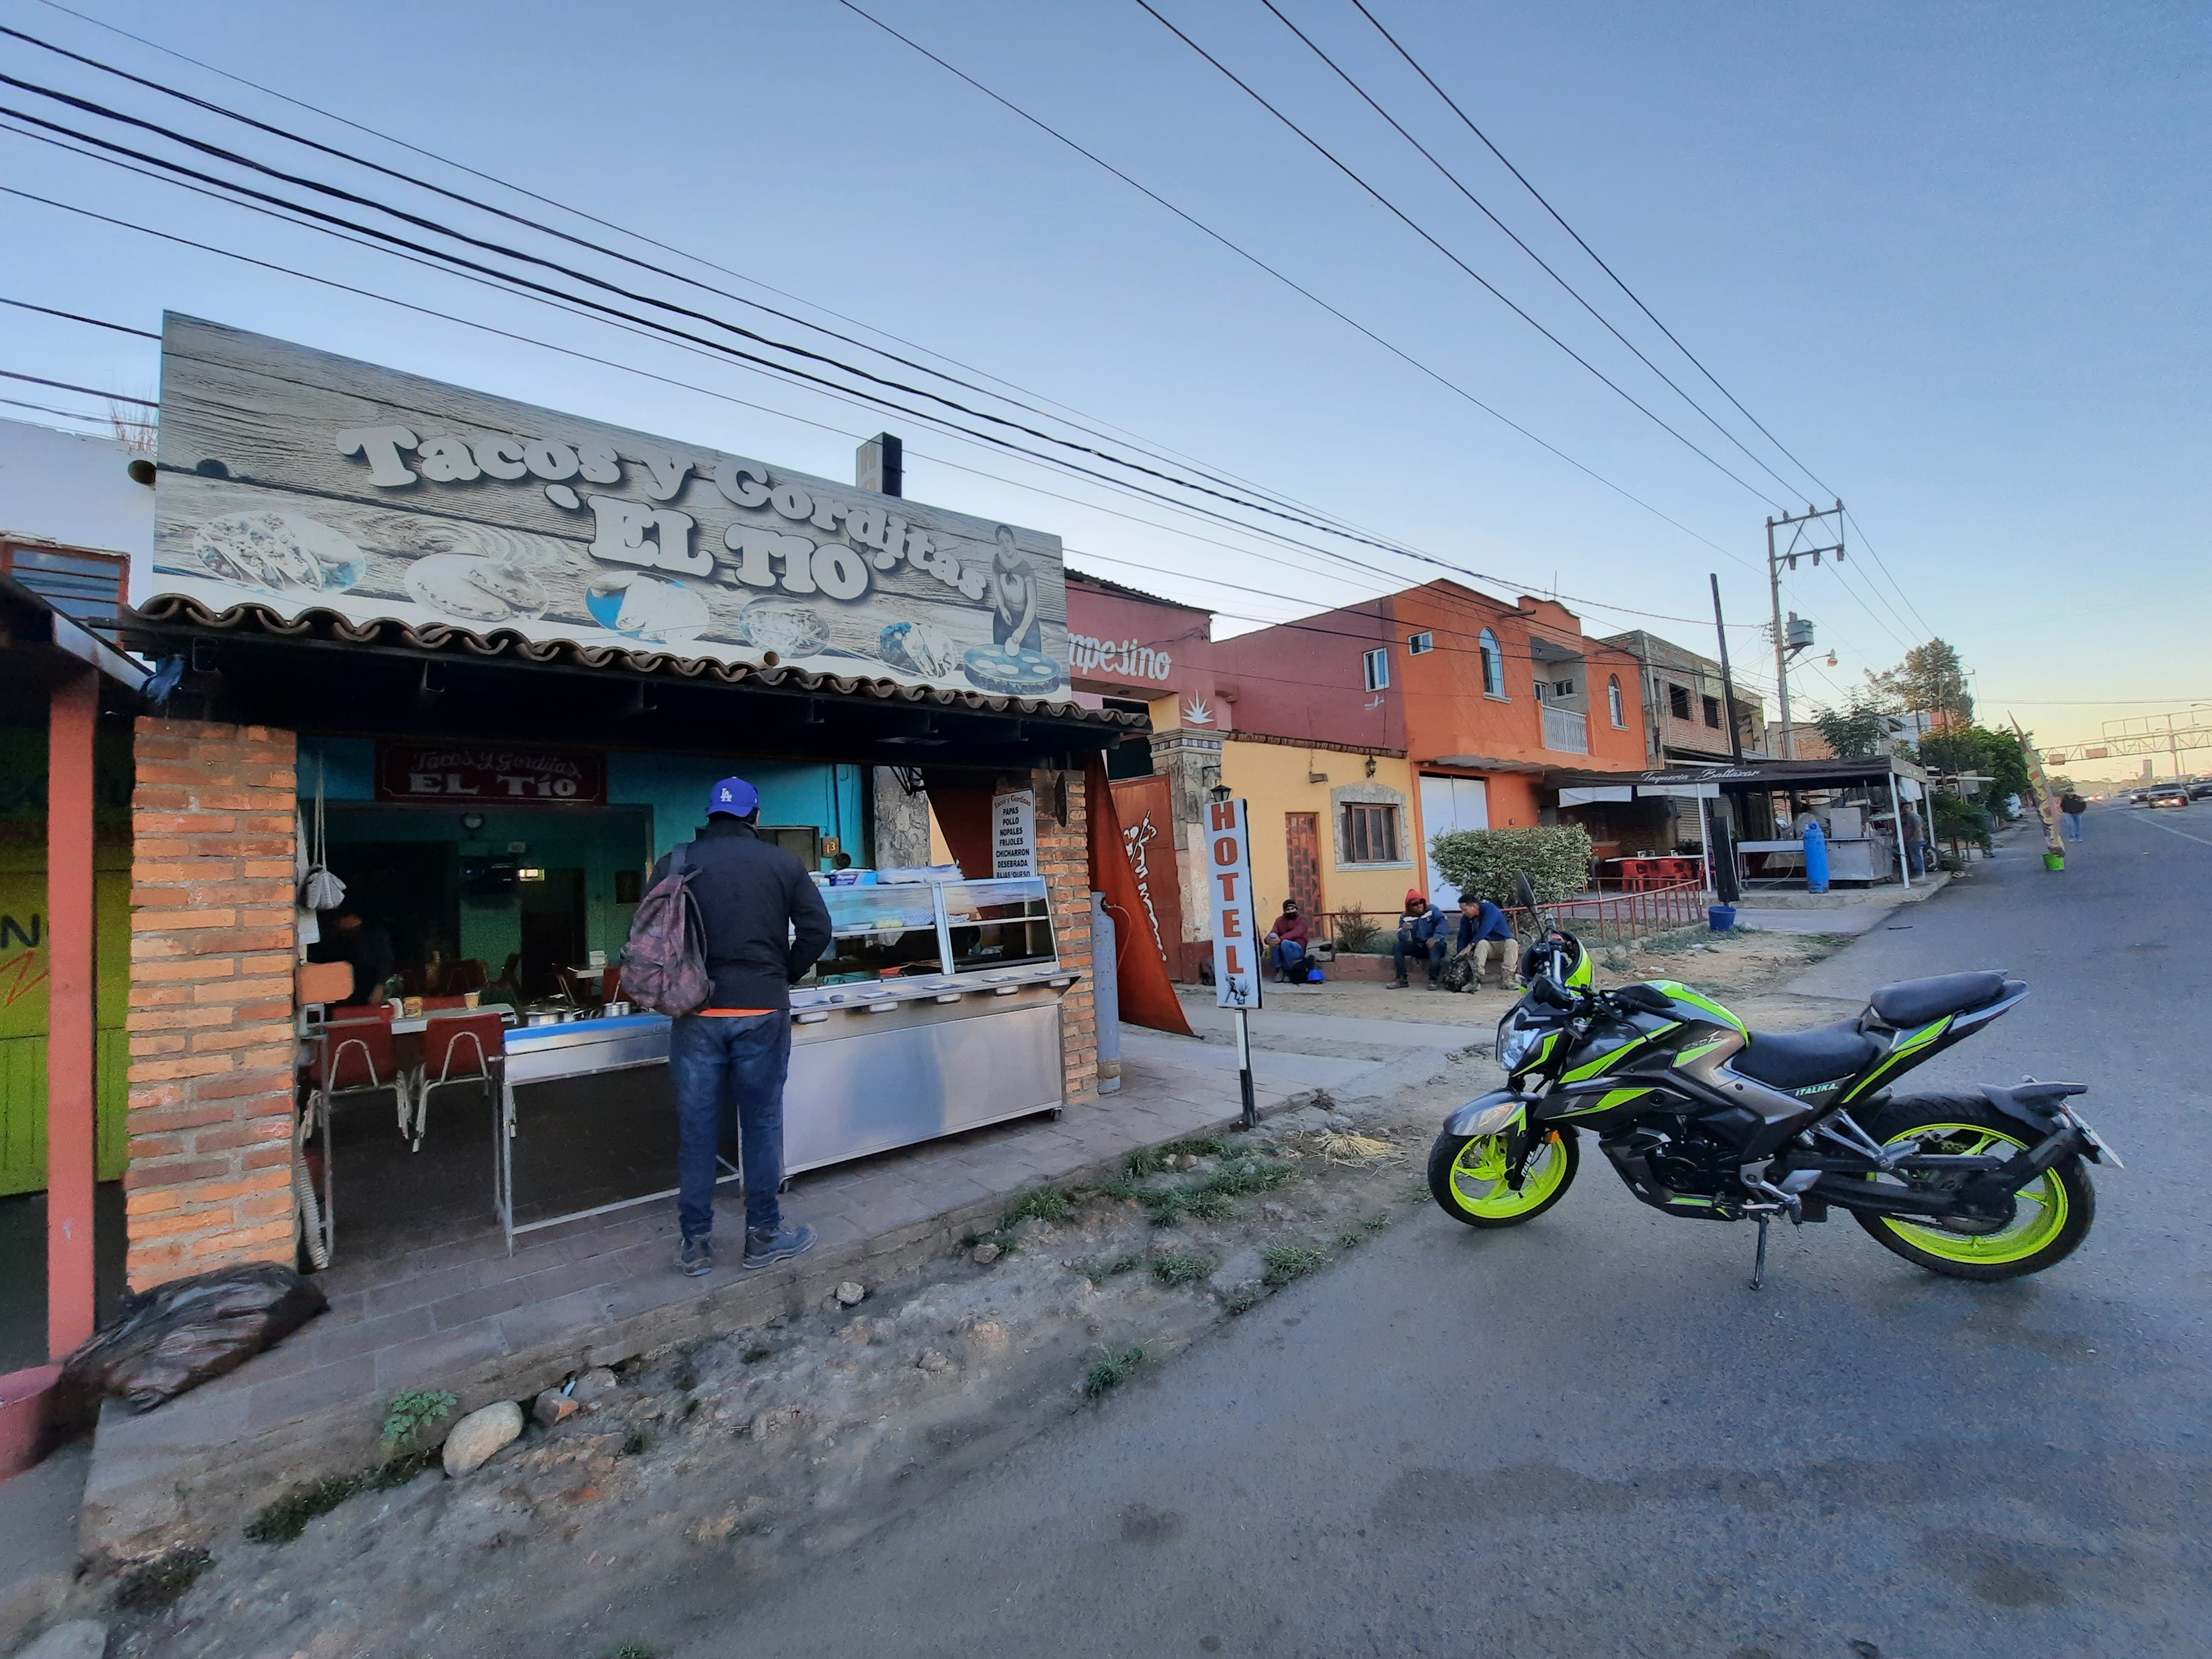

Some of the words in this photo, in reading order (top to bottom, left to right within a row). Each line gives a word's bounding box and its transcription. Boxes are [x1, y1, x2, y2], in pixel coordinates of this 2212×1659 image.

[336, 424, 621, 487] Tacos
[641, 455, 695, 500] y
[713, 460, 987, 600] Gorditas
[587, 495, 714, 577] EL
[411, 750, 476, 771] Tacos
[409, 772, 480, 795] EL
[720, 787, 732, 802] LA
[1003, 807, 1019, 816] PAPAS
[1003, 817, 1019, 826] POLLO
[1000, 827, 1022, 837] NOPALES
[999, 837, 1024, 847] FRIJOLES
[996, 848, 1030, 857] CHICHARRON
[998, 859, 1028, 868] DESEBRADA
[1211, 801, 1244, 974] HOTEL
[1795, 1083, 1836, 1097] ITALIKA
[1521, 1151, 1536, 1177] ITALIKA
